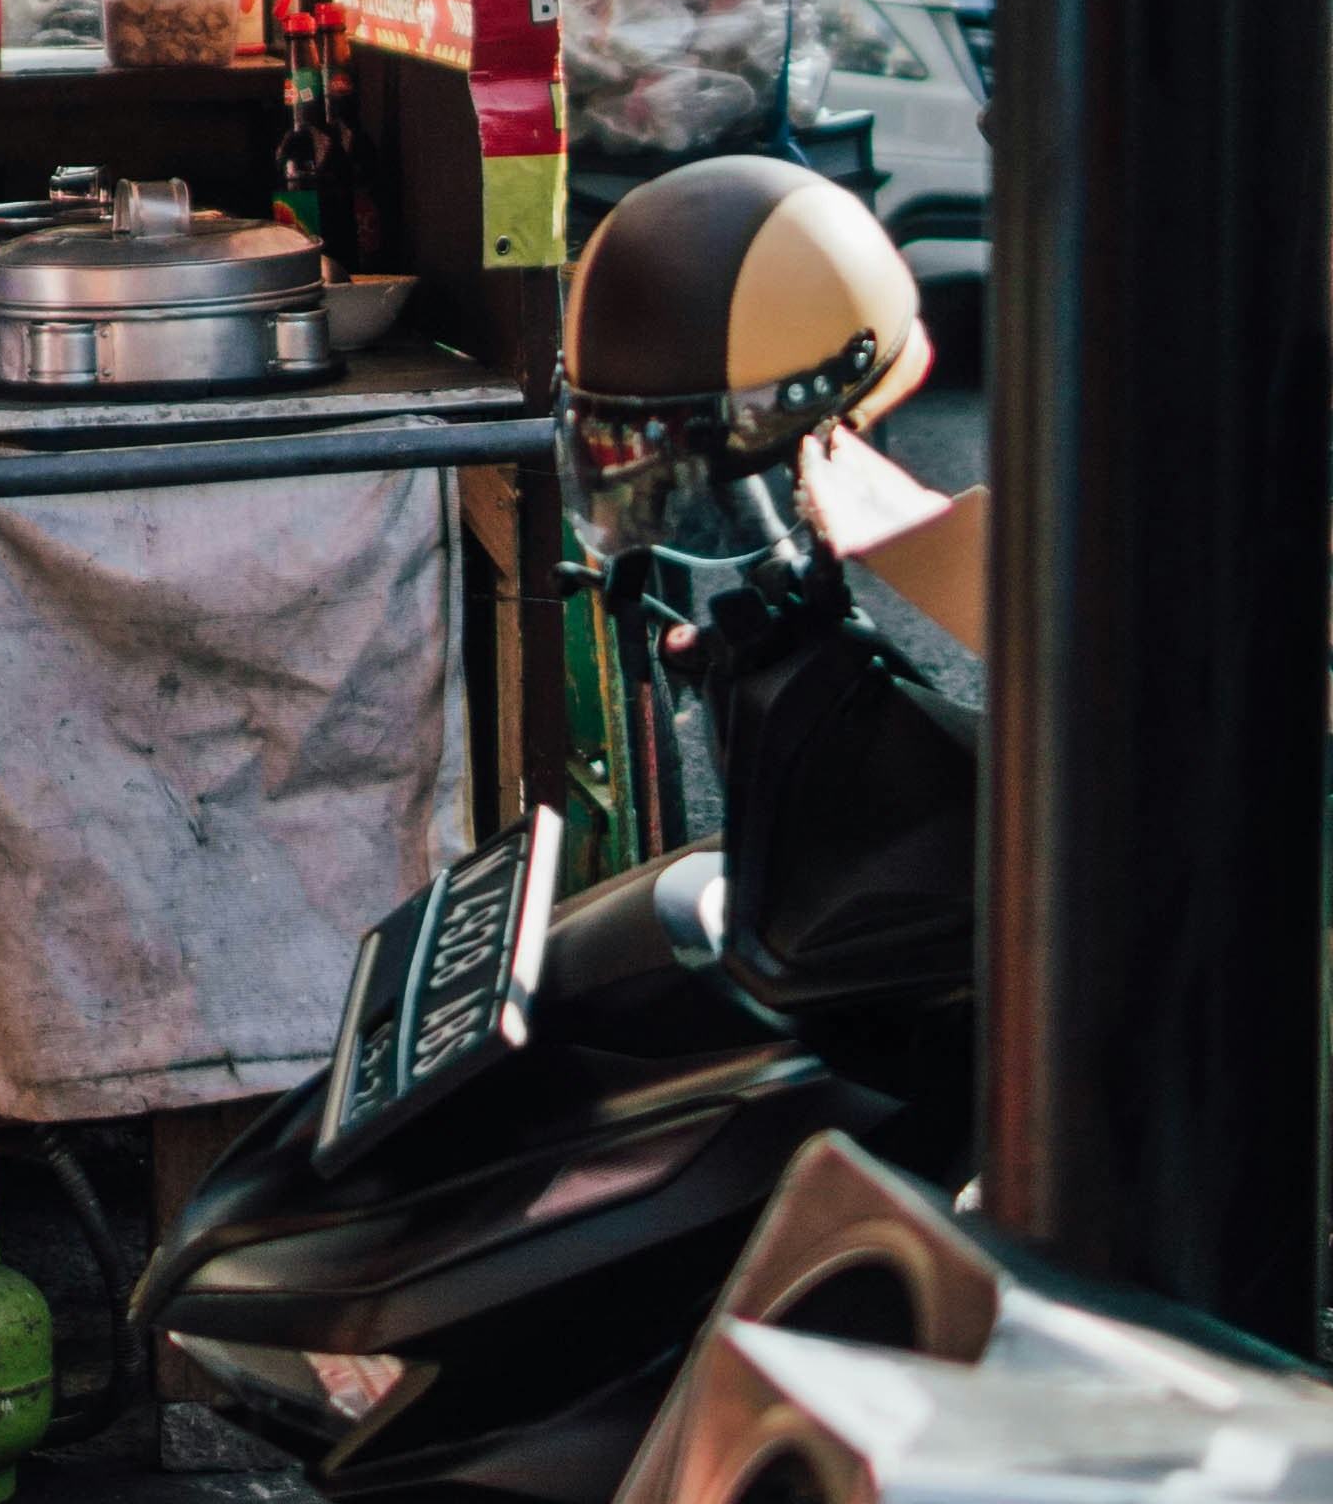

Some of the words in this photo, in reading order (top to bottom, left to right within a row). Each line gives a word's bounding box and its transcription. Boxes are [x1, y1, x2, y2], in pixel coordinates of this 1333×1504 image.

[446, 845, 514, 894] N
[429, 885, 508, 990] 4928
[412, 986, 488, 1079] ABS
